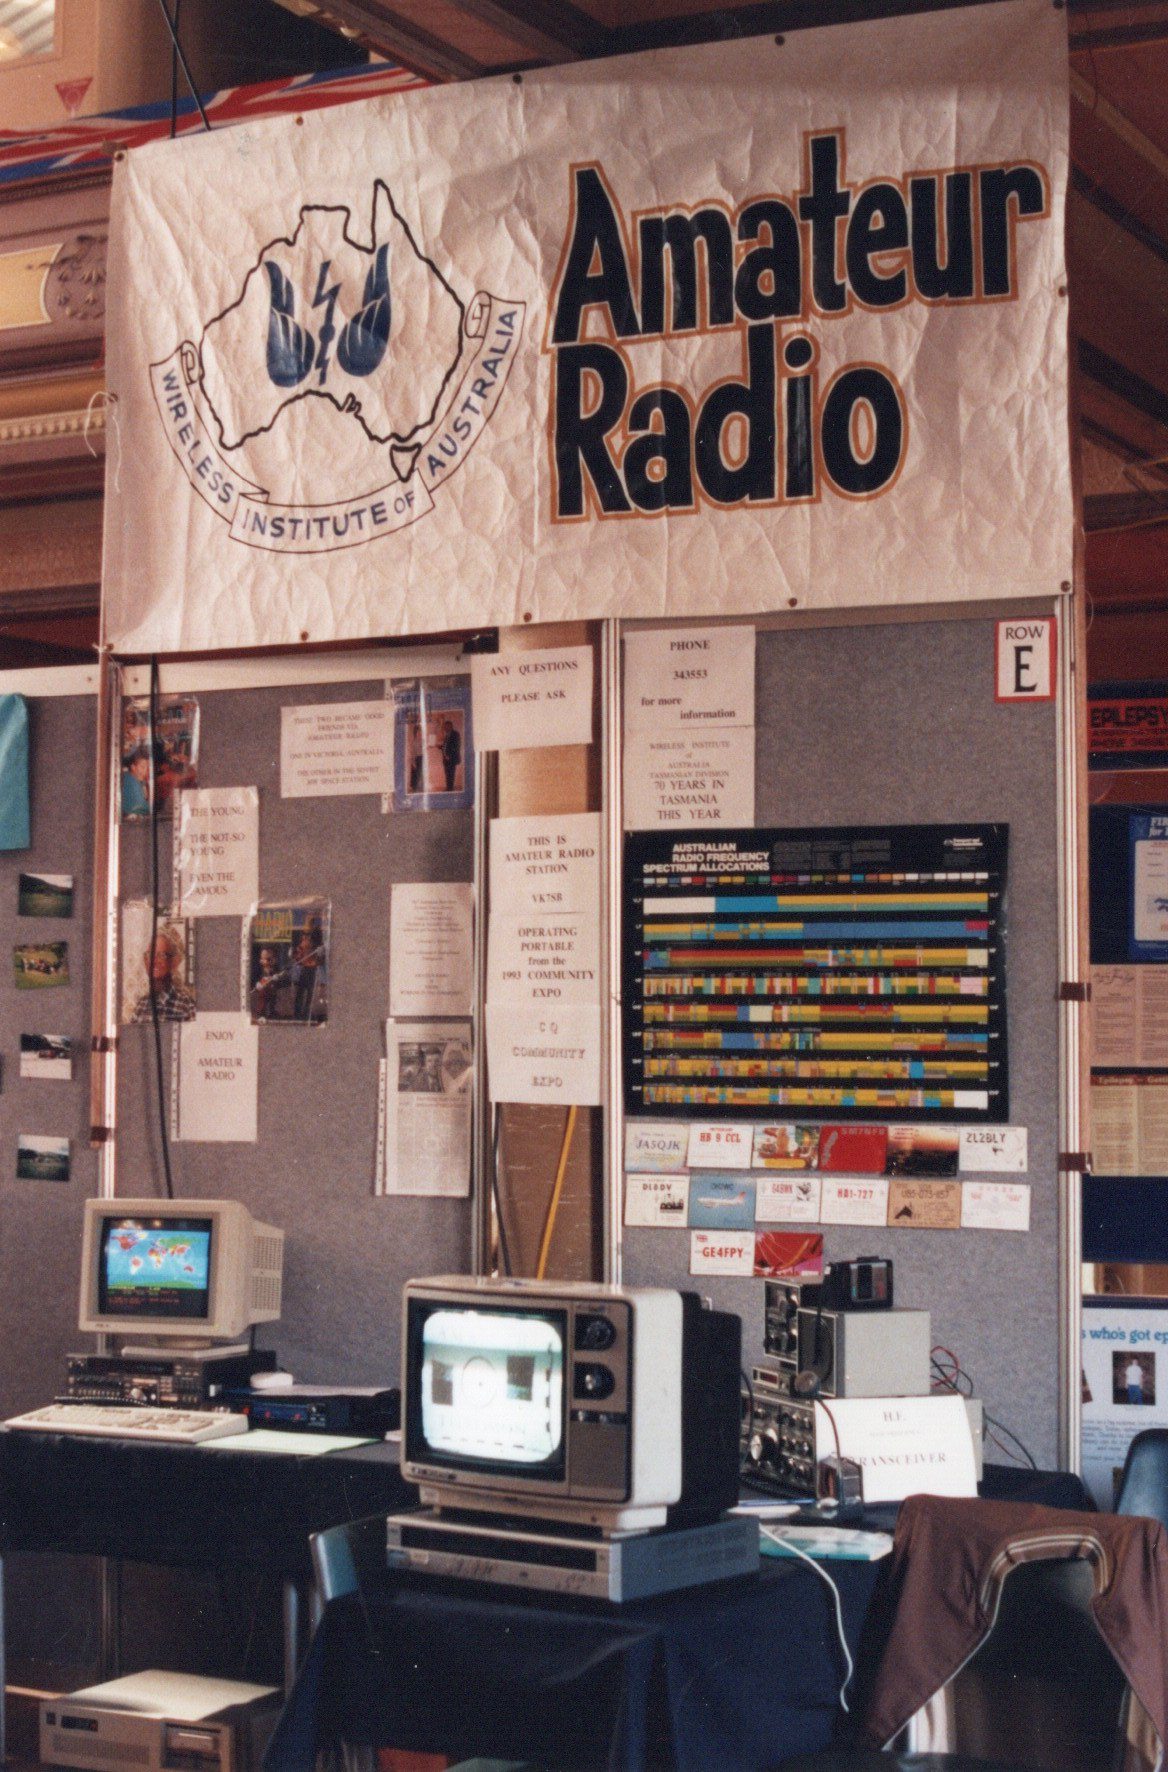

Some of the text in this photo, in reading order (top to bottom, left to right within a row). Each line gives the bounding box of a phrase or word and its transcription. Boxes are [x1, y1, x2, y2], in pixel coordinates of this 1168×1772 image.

[549, 133, 1045, 345] Amateur
[162, 310, 517, 539] WIRELESS INSTITUTE OF AUSTRALIA
[555, 322, 903, 518] Radio
[1005, 625, 1044, 640] ROW
[670, 639, 711, 651] PHONE
[491, 660, 579, 676] ANY QUESTIONS
[1013, 645, 1038, 693] E
[501, 689, 566, 703] PLEASE ASK
[641, 696, 682, 706] for more
[680, 708, 736, 720] information
[692, 740, 731, 749] INSTITUTE
[670, 780, 706, 790] YEARS
[712, 779, 725, 789] IN
[660, 794, 718, 805] TASMANIA
[657, 808, 722, 820] THIS YEAR
[528, 834, 567, 846] THIS IS
[672, 842, 737, 853] AUSTRALIAN
[505, 847, 595, 862] AMATEUR RADIO
[672, 851, 770, 863] RADIO FREQUENCY
[526, 863, 568, 875] STATION
[642, 861, 770, 874] SPECTRUM ALLOCATIONS
[216, 872, 235, 881] THE
[193, 886, 228, 895] AMOUS
[518, 926, 578, 938] OPERATING
[521, 940, 575, 952] PORTABLE
[528, 955, 566, 966] from the
[527, 970, 595, 981] COMMUNITY
[532, 987, 562, 998] EXPO
[512, 1046, 586, 1060] COMMUNITY
[198, 1057, 243, 1067] AMATEUR
[204, 1071, 235, 1081] RADIO
[531, 1076, 563, 1089] EXPO
[702, 1246, 744, 1258] GE4FPY
[1090, 1326, 1126, 1340] who's
[1129, 1328, 1151, 1345] got
[850, 1452, 946, 1467] RANSCEIVER
